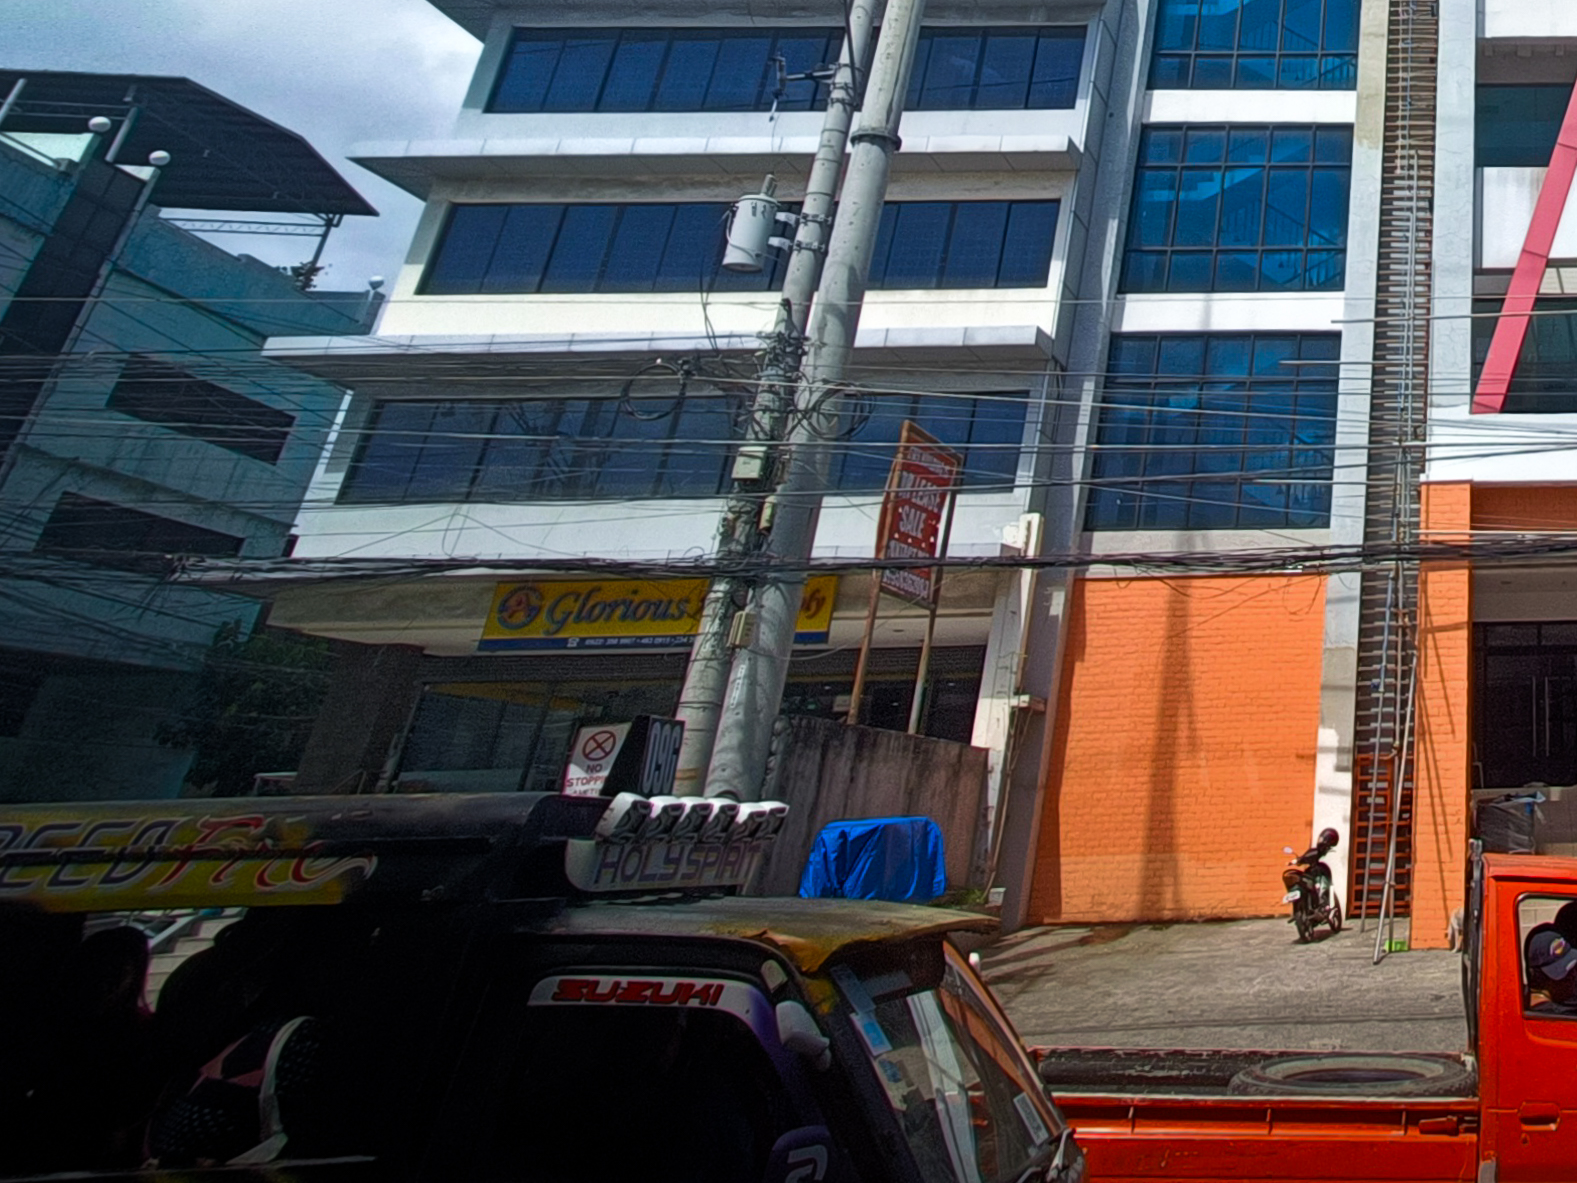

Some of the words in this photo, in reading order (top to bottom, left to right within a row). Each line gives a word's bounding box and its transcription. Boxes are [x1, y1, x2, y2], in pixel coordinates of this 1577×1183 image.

[544, 586, 690, 636] Glorious
[586, 763, 603, 774] NO
[551, 978, 724, 1007] SUZUKI
